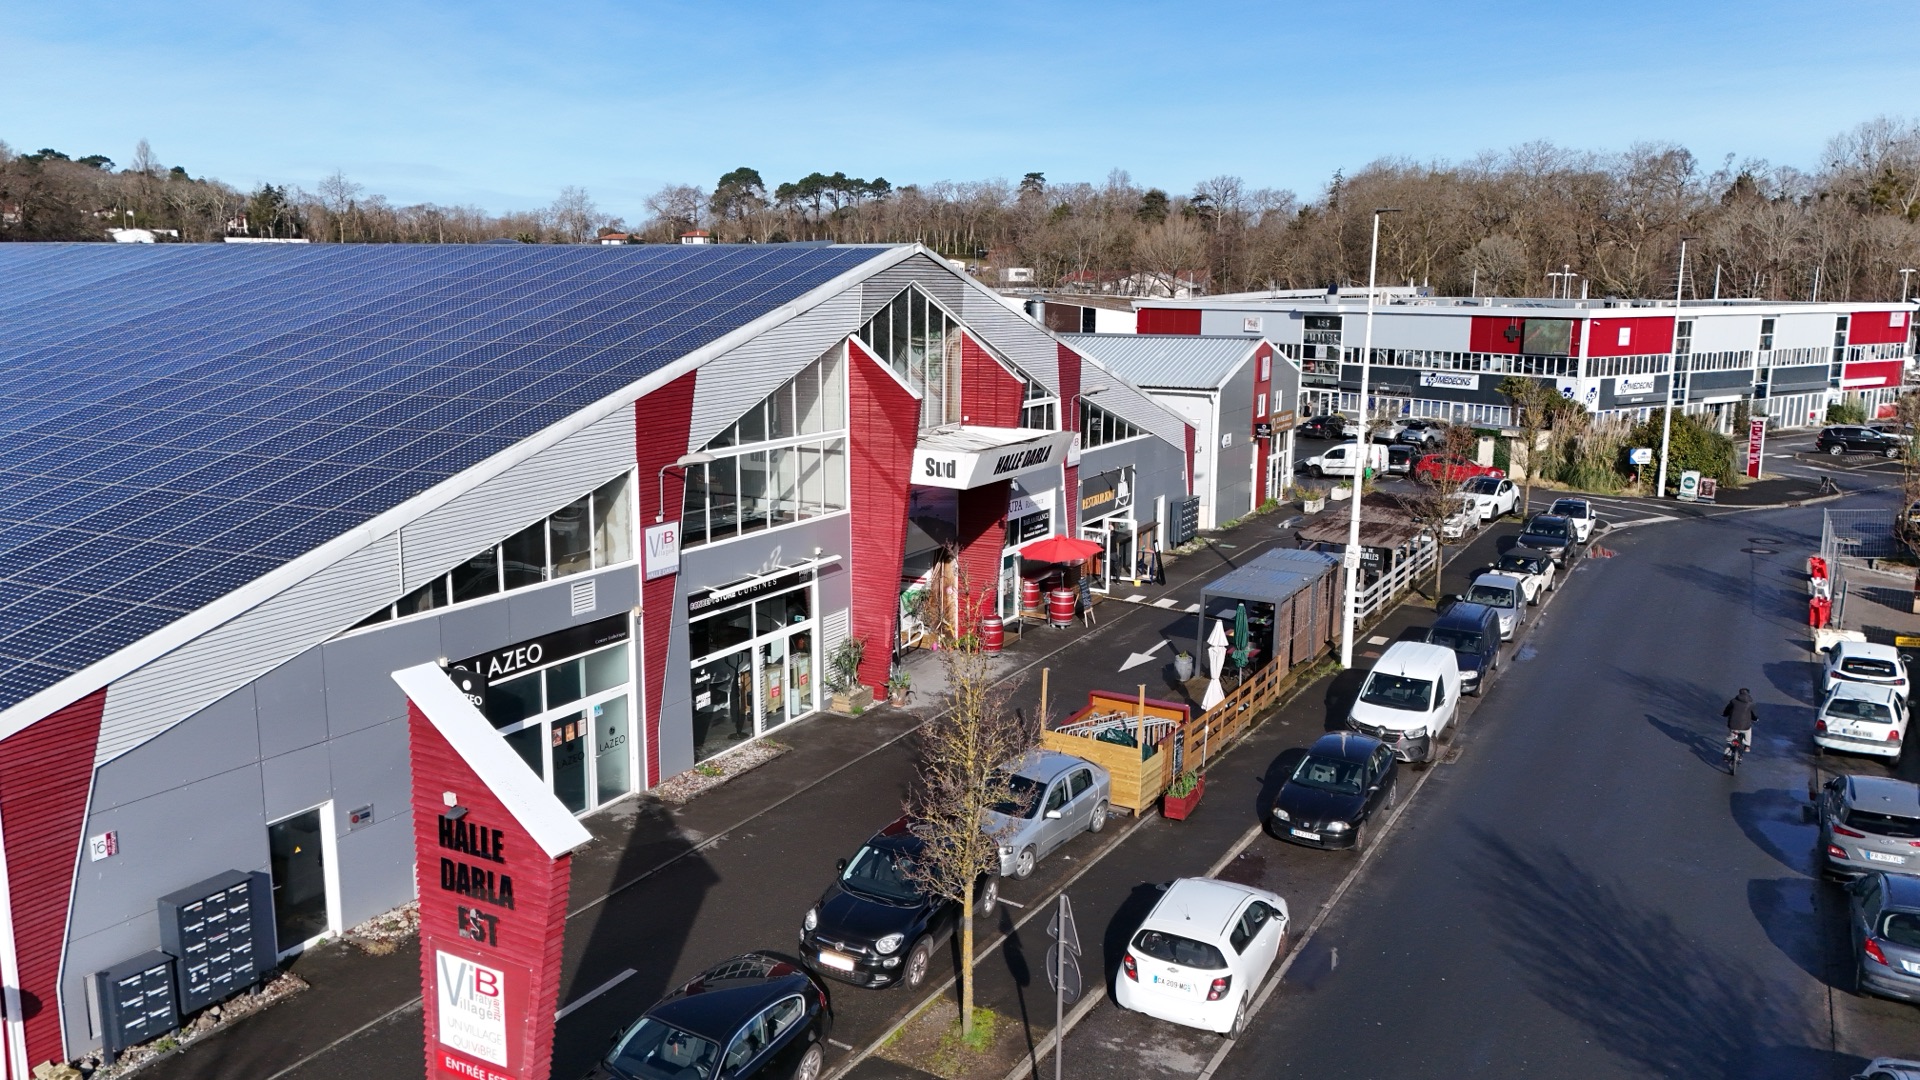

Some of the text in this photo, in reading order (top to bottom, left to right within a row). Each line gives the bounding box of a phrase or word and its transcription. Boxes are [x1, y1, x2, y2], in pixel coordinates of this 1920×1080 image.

[925, 457, 956, 479] Sud
[993, 445, 1053, 475] HALLE DARLA
[1007, 499, 1023, 513] UPA
[1082, 489, 1115, 510] RESTAURANT
[738, 578, 777, 596] CUISINES
[464, 693, 483, 706] ZEO
[599, 734, 626, 752] LAZEO
[556, 751, 584, 770] LAZEO
[92, 840, 107, 855] 16
[438, 814, 505, 864] HALLE
[440, 857, 515, 911] DARLA
[457, 905, 499, 947] EST
[447, 1015, 503, 1045] UN VILLAGE
[453, 1034, 471, 1050] QUI
[445, 1056, 486, 1080] ENTRÉE
